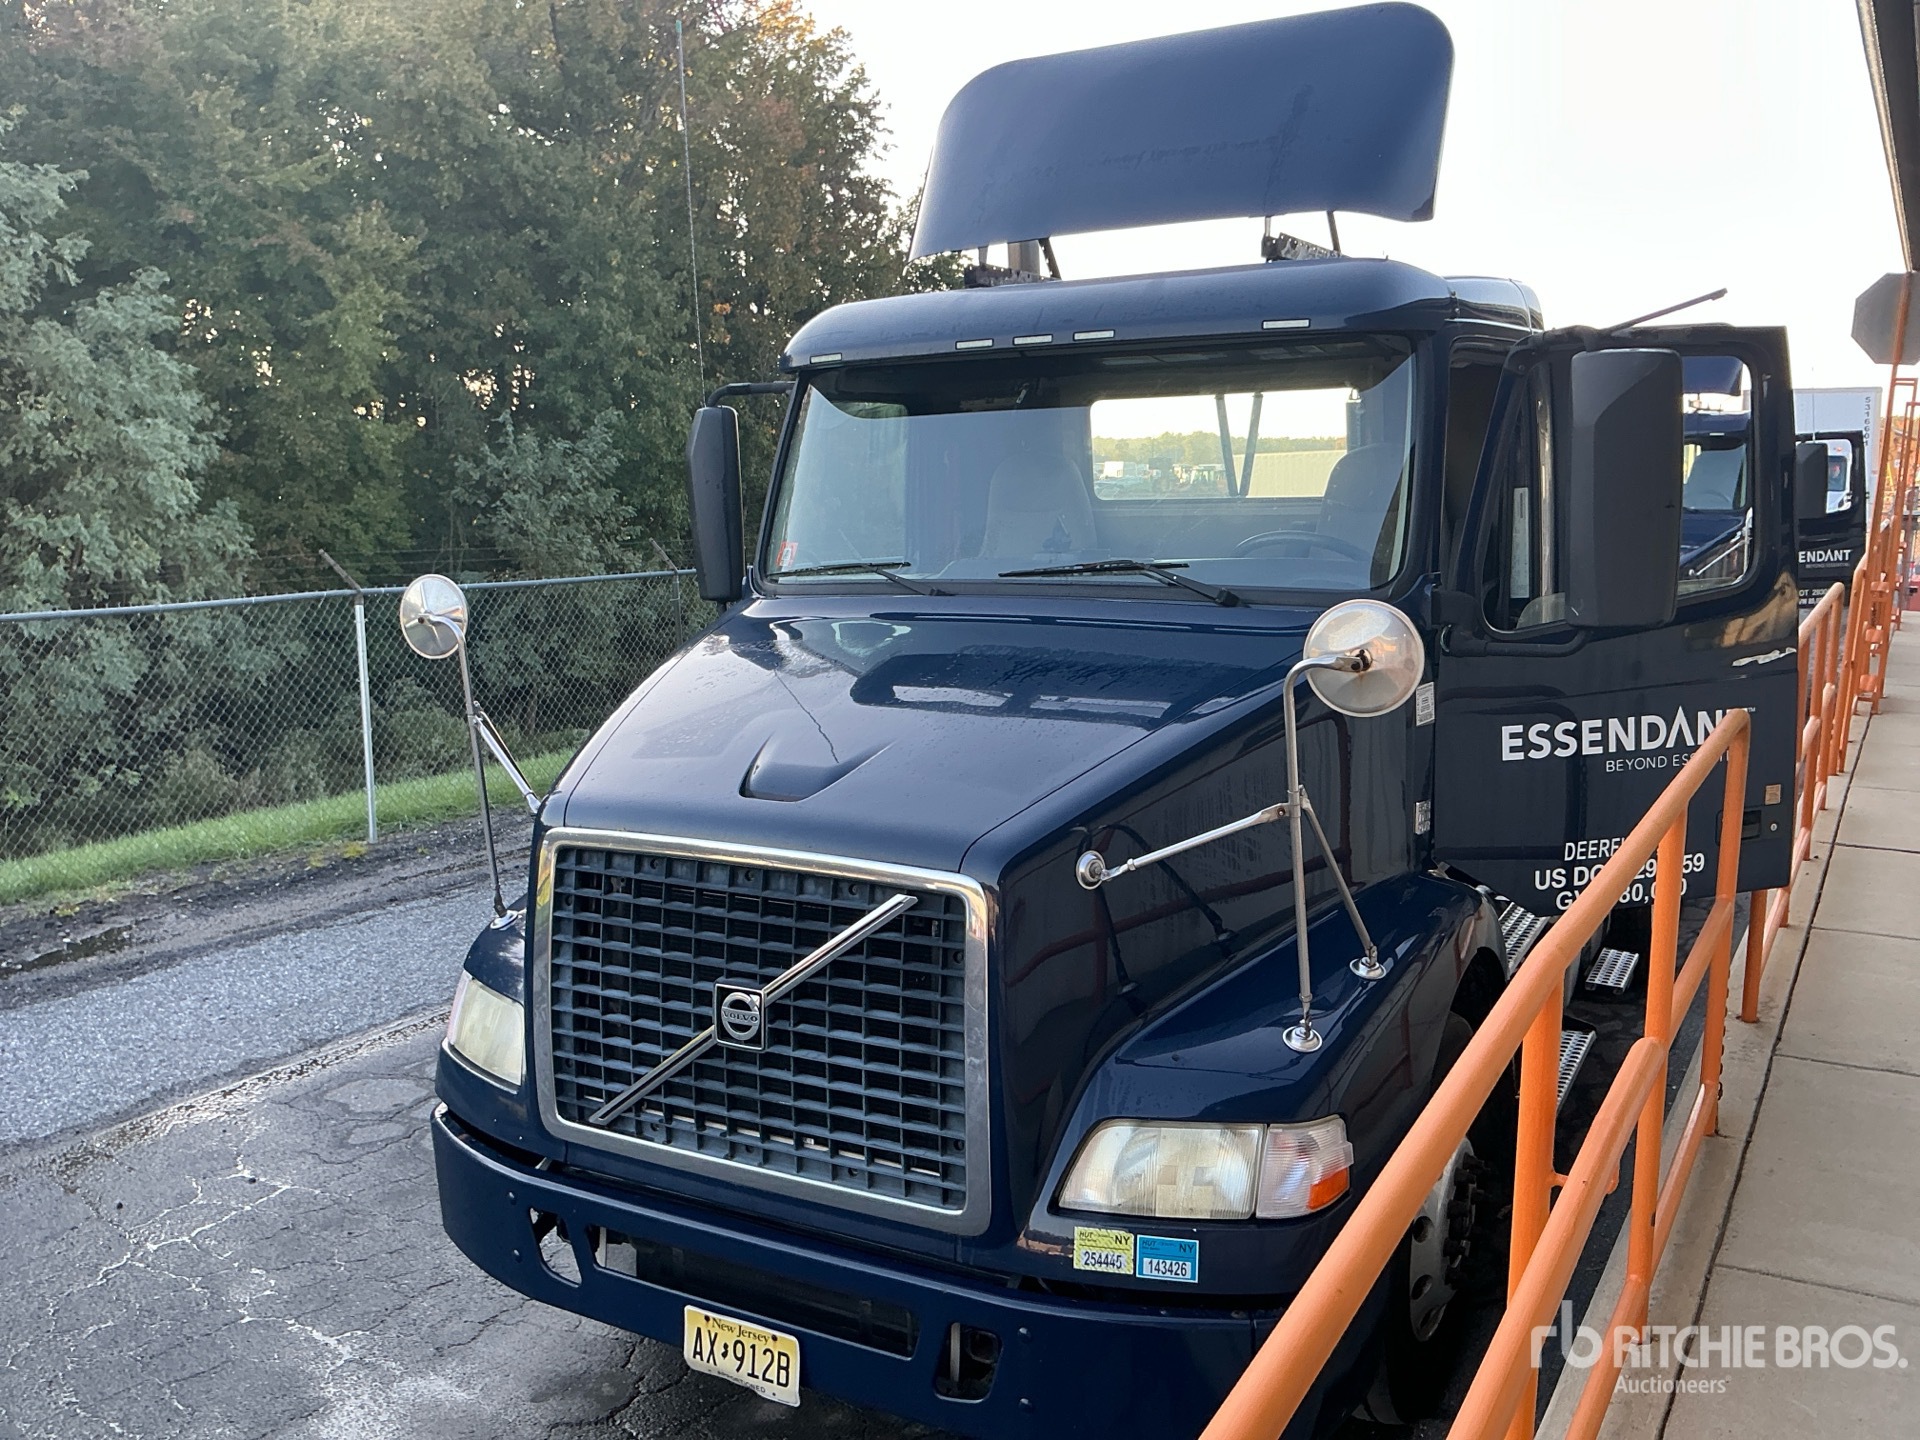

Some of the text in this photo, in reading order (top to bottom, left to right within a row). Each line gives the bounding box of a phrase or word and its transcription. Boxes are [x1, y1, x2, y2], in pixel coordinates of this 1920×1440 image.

[1798, 549, 1851, 563] ENDANT
[1502, 705, 1748, 762] ESSENDAN
[1605, 755, 1667, 772] BEYOND
[1564, 837, 1625, 861] DEERF
[1534, 868, 1567, 891] US
[1573, 863, 1605, 887] DO
[723, 1010, 758, 1023] VOLVO
[1114, 1235, 1130, 1246] NY
[1179, 1243, 1195, 1253] NY
[1084, 1251, 1123, 1270] 254445
[1148, 1259, 1187, 1277] 143426
[711, 1317, 771, 1345] New Jersey
